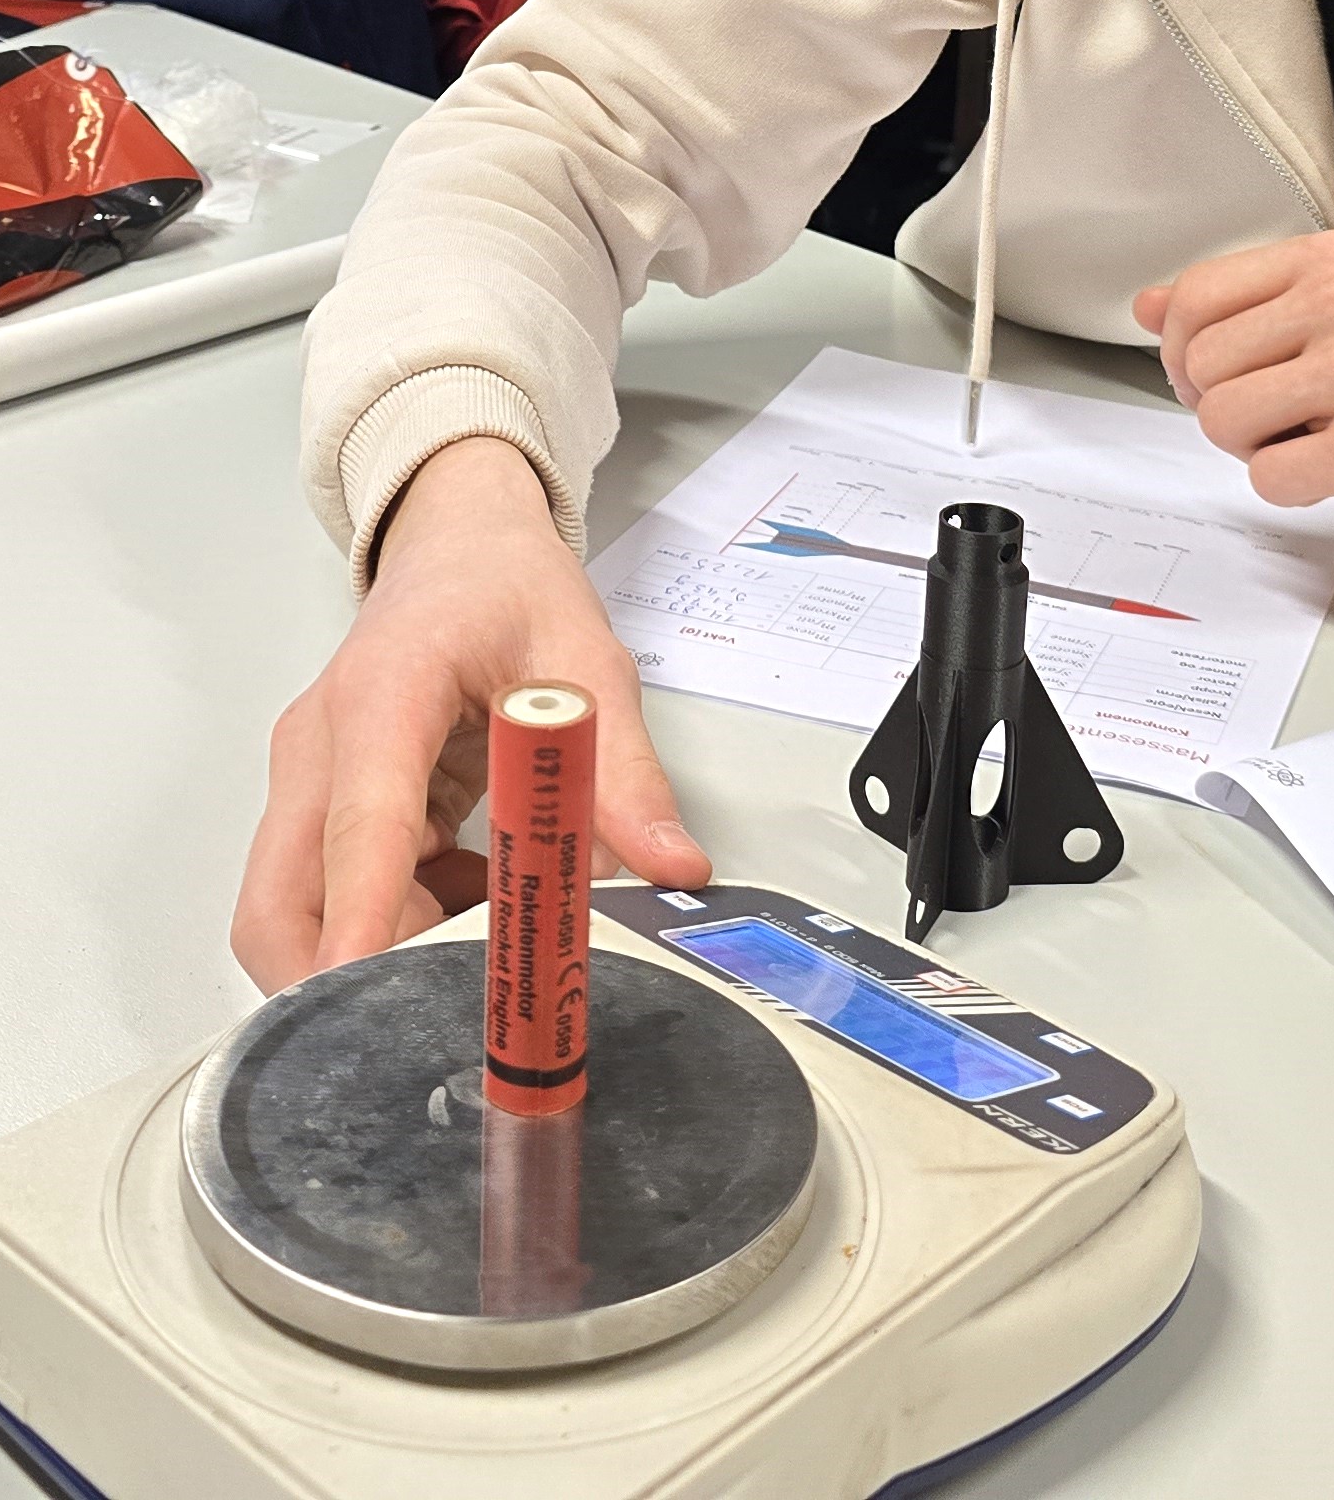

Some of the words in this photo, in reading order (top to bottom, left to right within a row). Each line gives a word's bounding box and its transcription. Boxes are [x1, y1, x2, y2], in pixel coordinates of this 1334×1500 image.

[1190, 684, 1232, 698] Kropp
[1196, 676, 1238, 688] Motor
[1094, 710, 1190, 737] Komponent
[497, 830, 514, 897] Model
[496, 898, 513, 975] Rocket
[517, 874, 540, 1023] Raketenmotor
[494, 977, 513, 1051] Engine
[972, 1104, 1072, 1151] KERN
